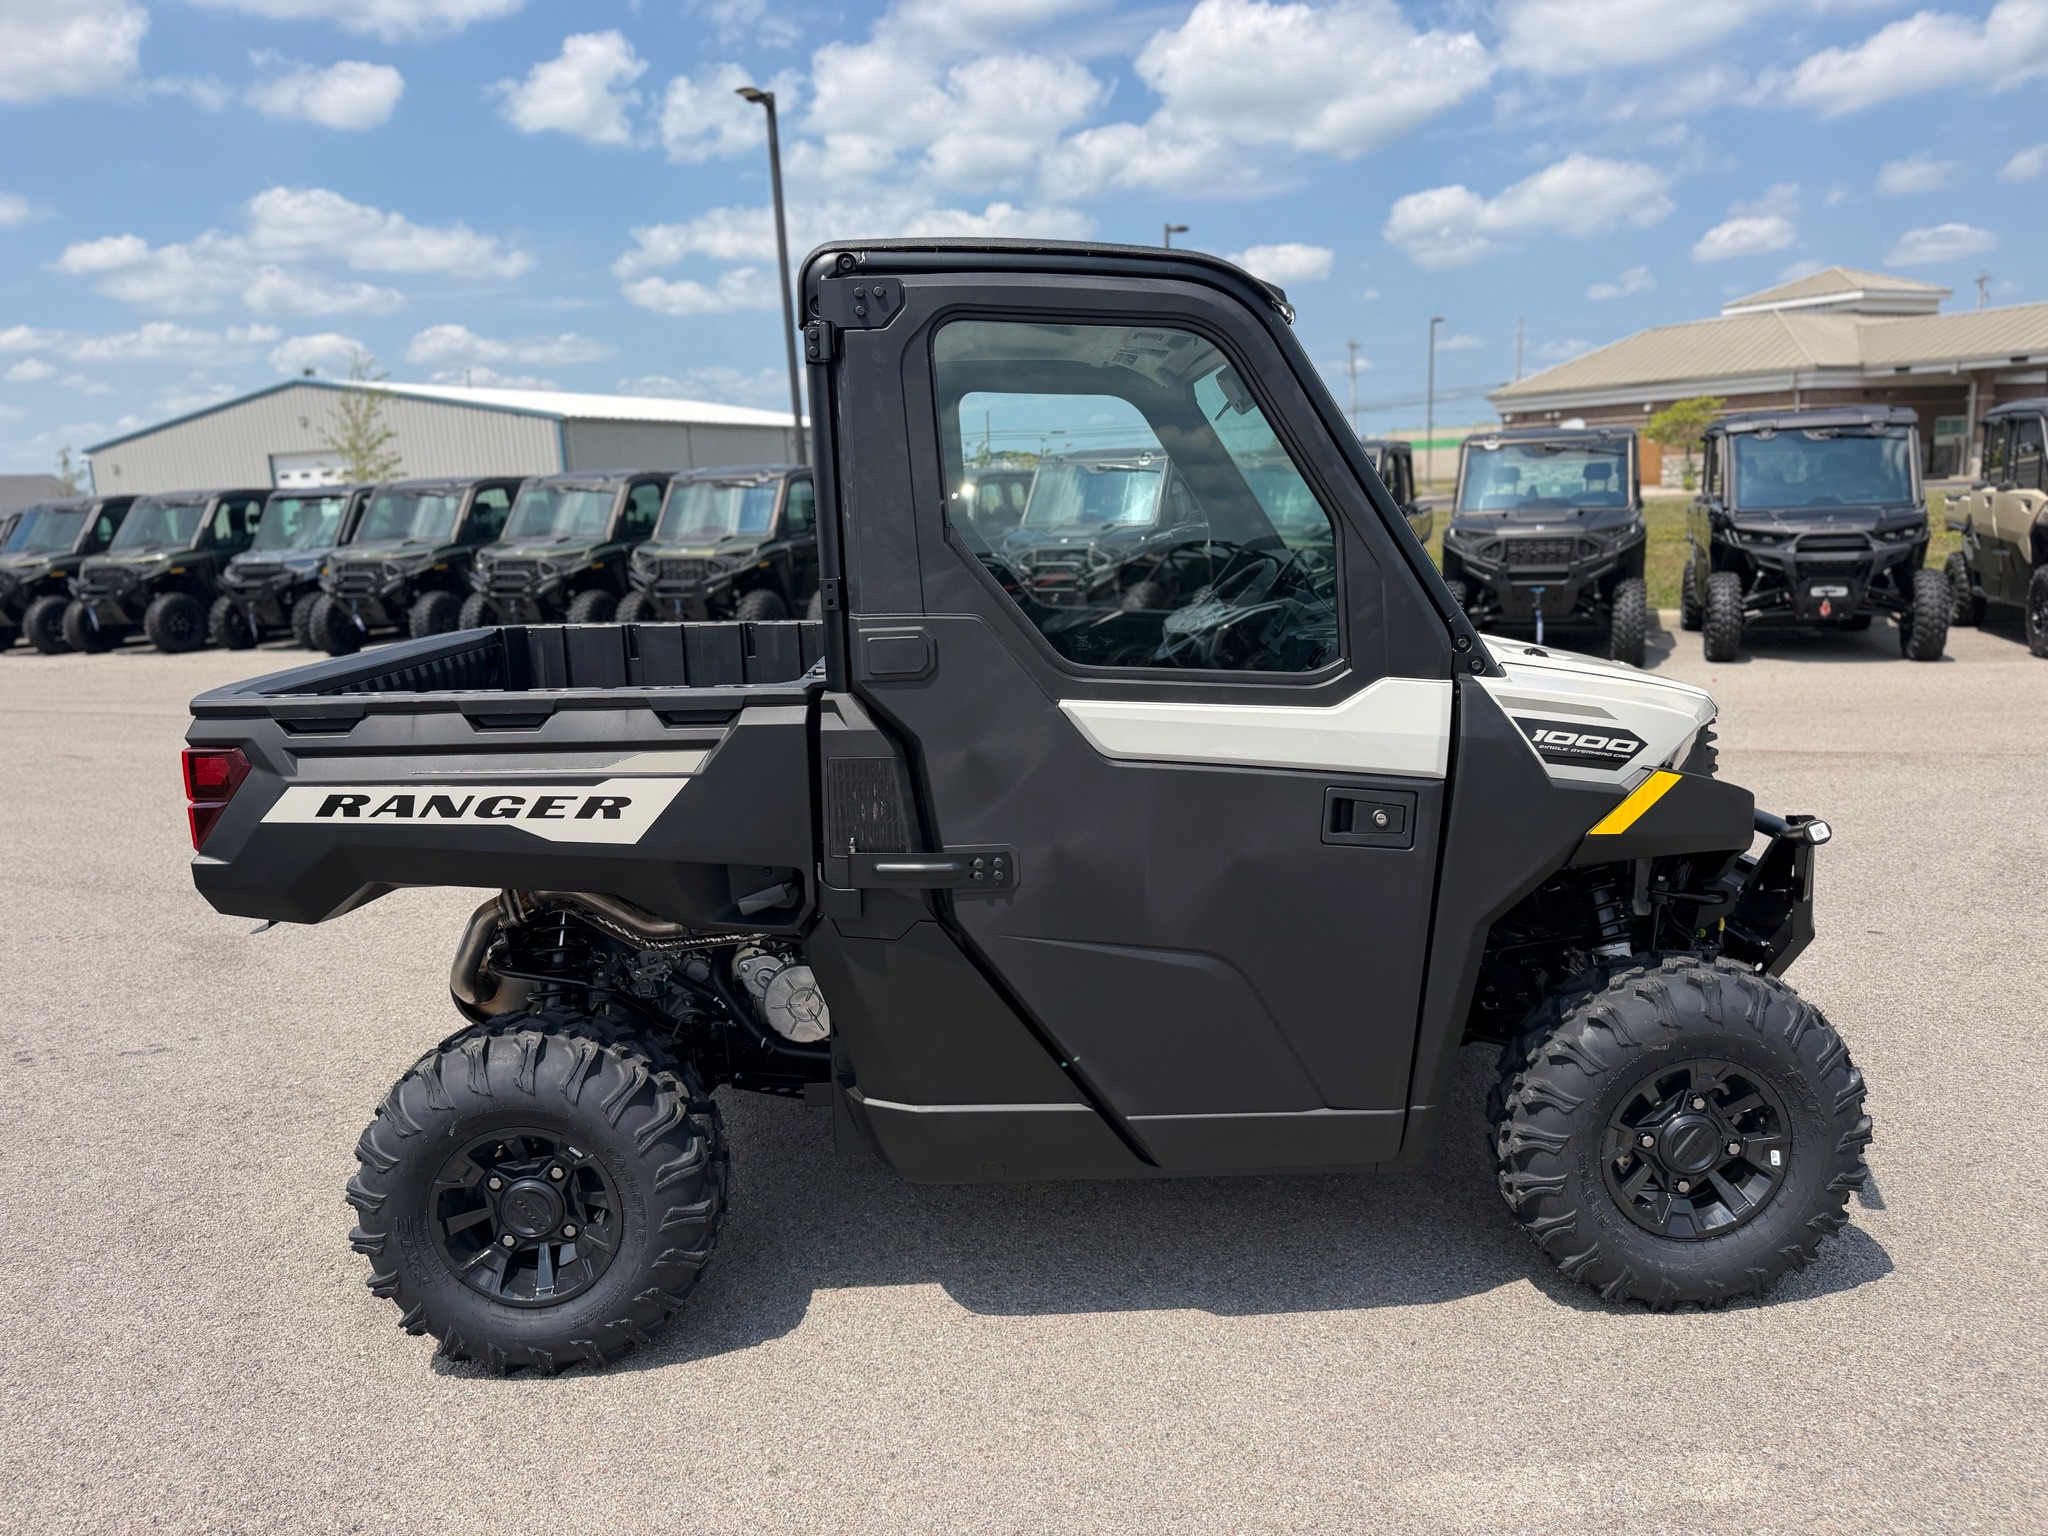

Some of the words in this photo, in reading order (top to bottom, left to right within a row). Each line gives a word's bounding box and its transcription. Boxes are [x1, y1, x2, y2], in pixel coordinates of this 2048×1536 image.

[1532, 729, 1639, 753] 1000
[1538, 744, 1569, 752] SINGLE
[1570, 748, 1612, 757] OVERHEAD
[315, 794, 632, 820] RANGER
[1578, 1151, 1631, 1249] CARLSTAR
